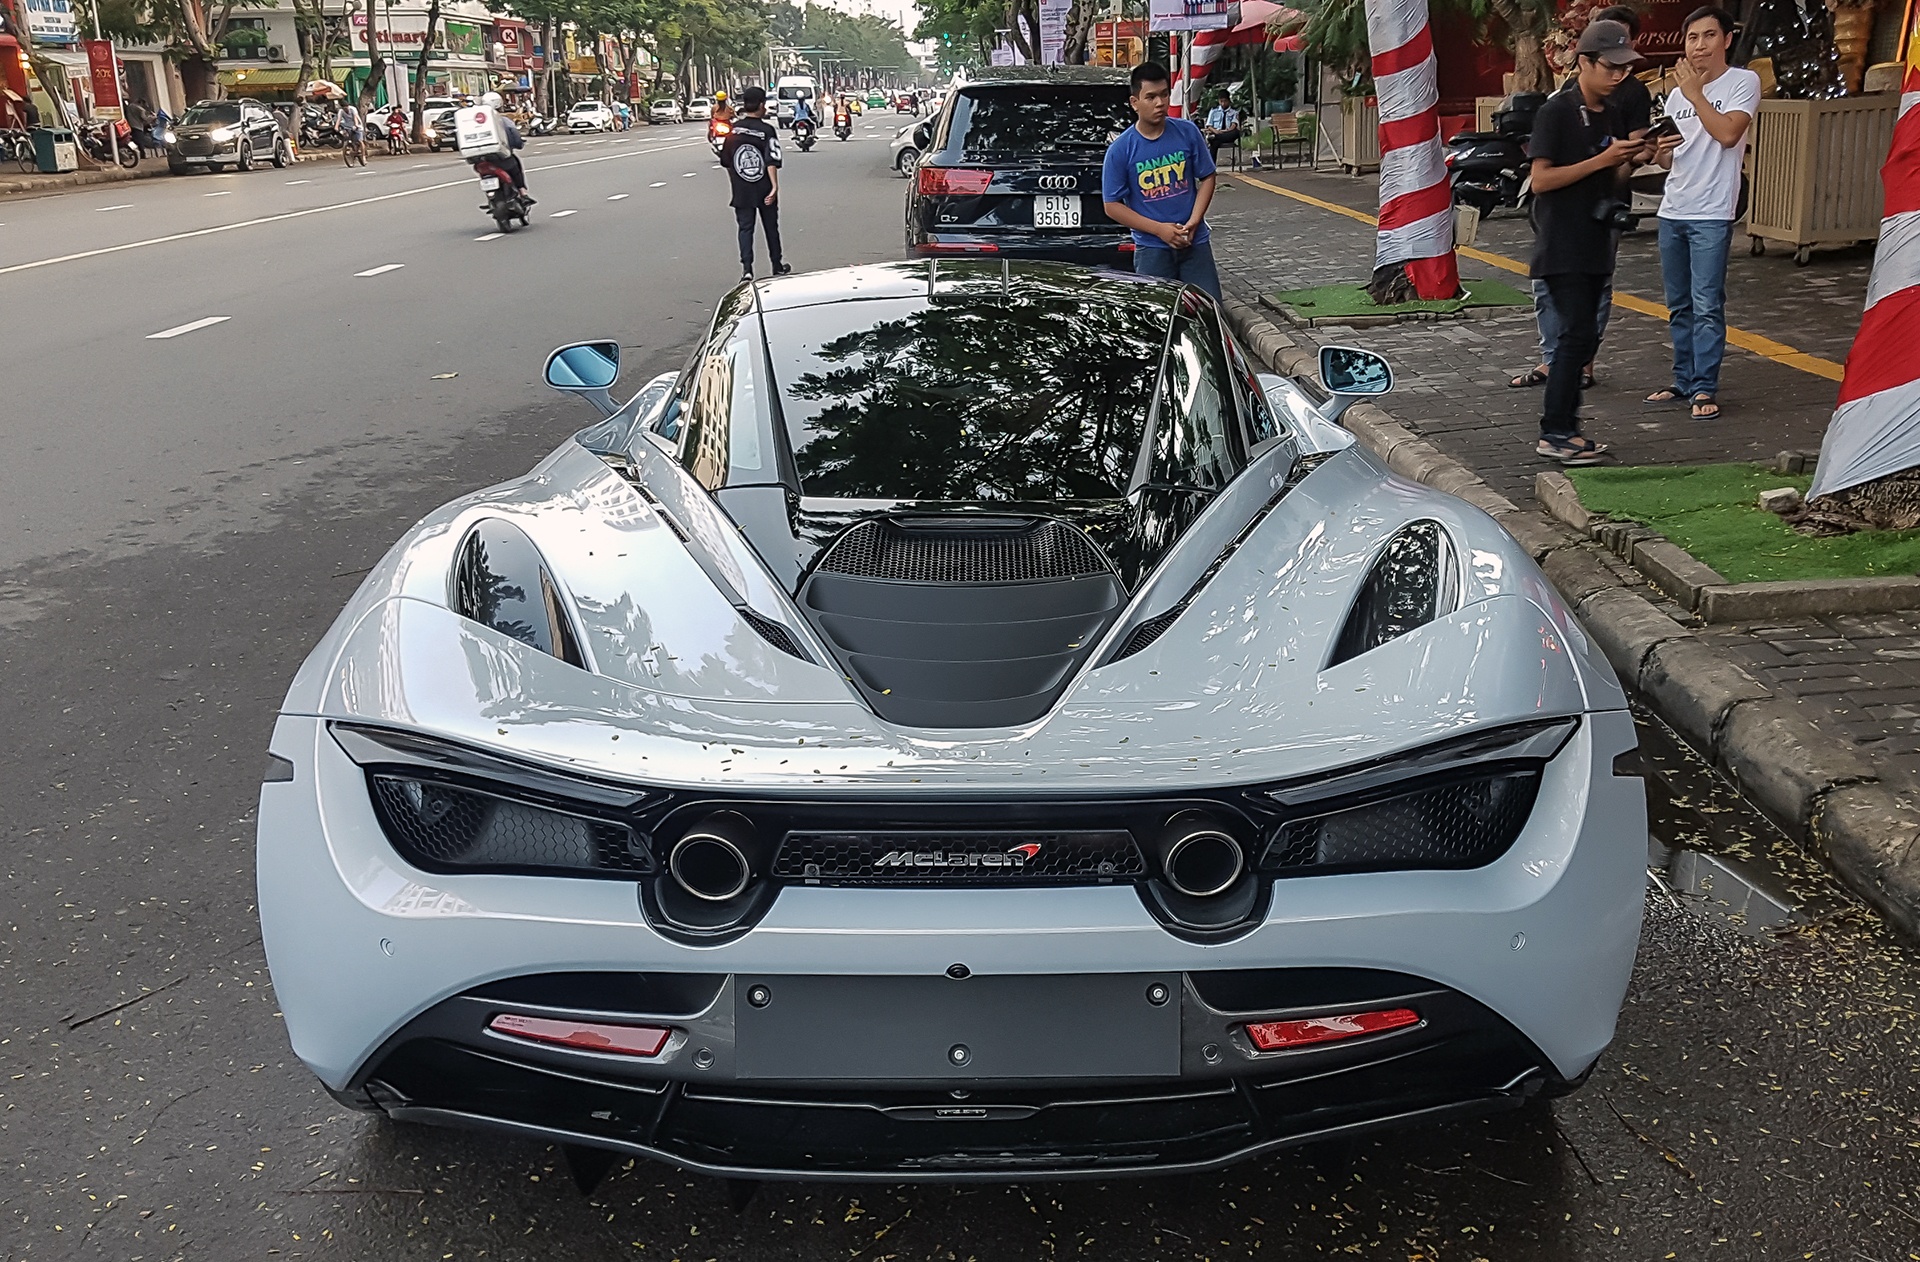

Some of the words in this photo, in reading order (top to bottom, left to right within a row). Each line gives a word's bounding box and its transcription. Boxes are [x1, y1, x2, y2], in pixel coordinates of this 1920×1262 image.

[359, 29, 427, 44] Ctimart
[1136, 151, 1185, 174] DANANG
[1138, 161, 1186, 190] CITY
[1046, 197, 1070, 211] 51G
[940, 214, 959, 223] Q7
[1037, 212, 1079, 225] 356.19
[874, 851, 1024, 867] McLaren
